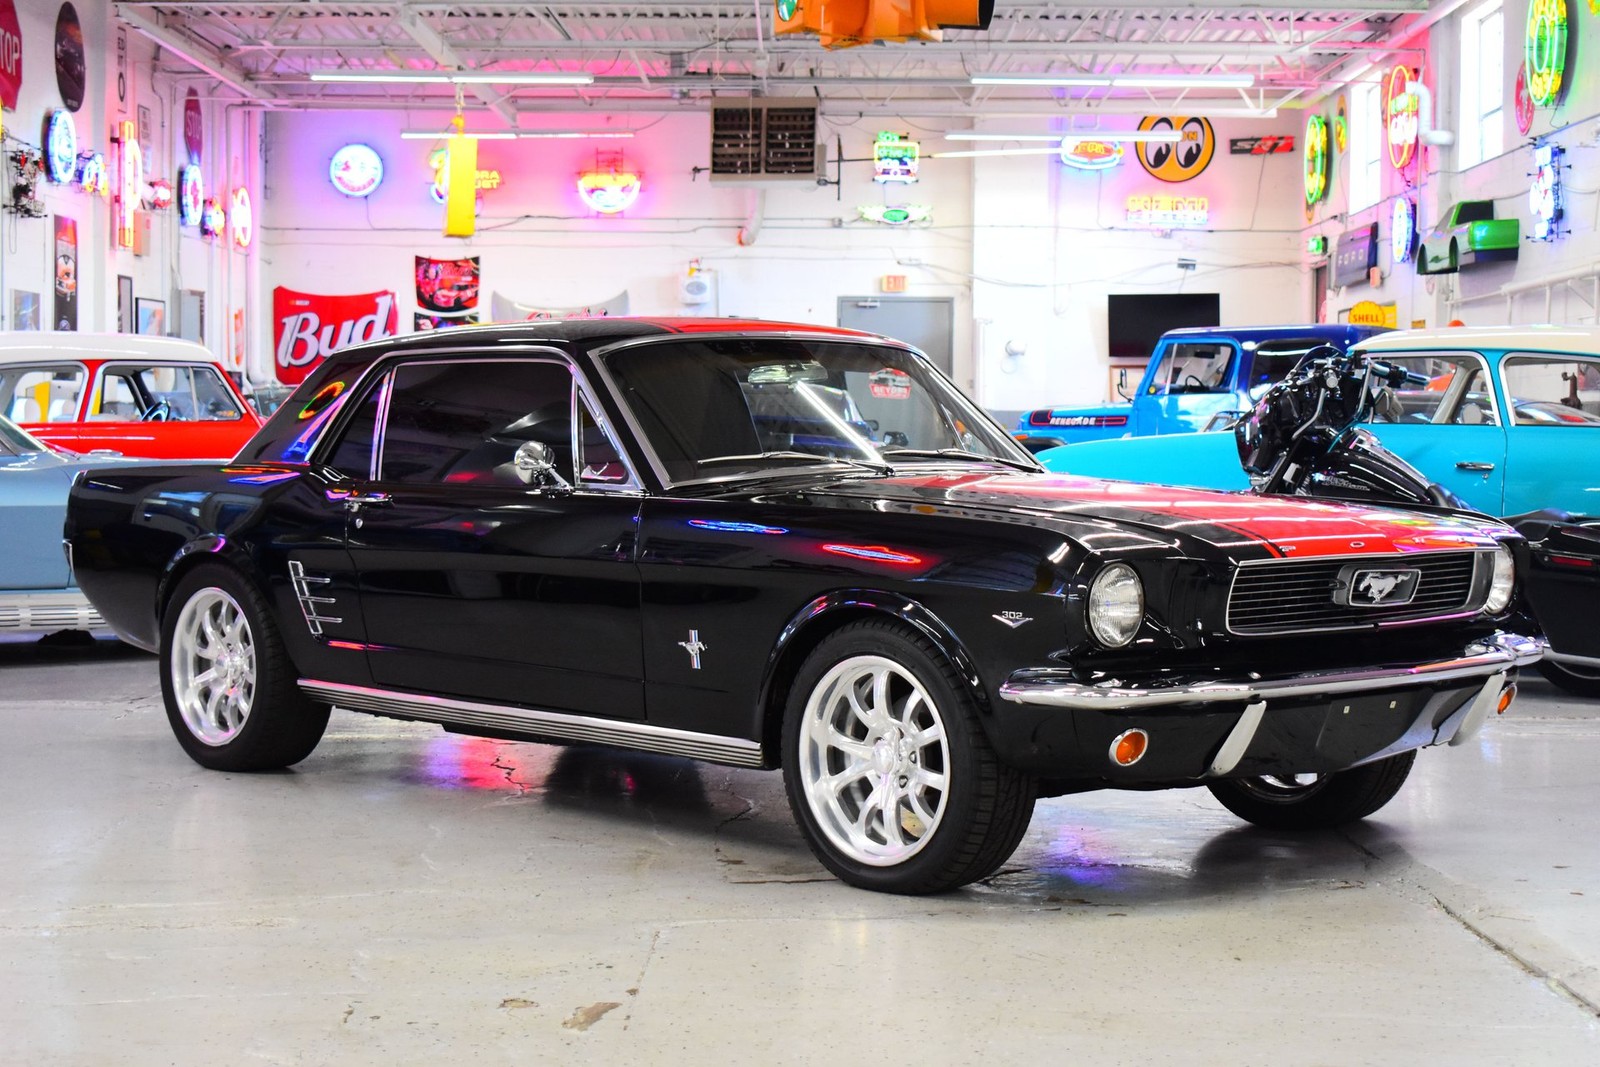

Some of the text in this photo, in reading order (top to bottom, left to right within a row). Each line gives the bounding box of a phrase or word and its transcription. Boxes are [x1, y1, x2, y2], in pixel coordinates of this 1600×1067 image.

[0, 27, 20, 76] TOP
[1232, 140, 1292, 151] SRT
[1352, 314, 1380, 324] SHELL
[277, 293, 393, 369] Bud
[1049, 416, 1097, 427] RENEGADE
[1001, 610, 1024, 620] 302
